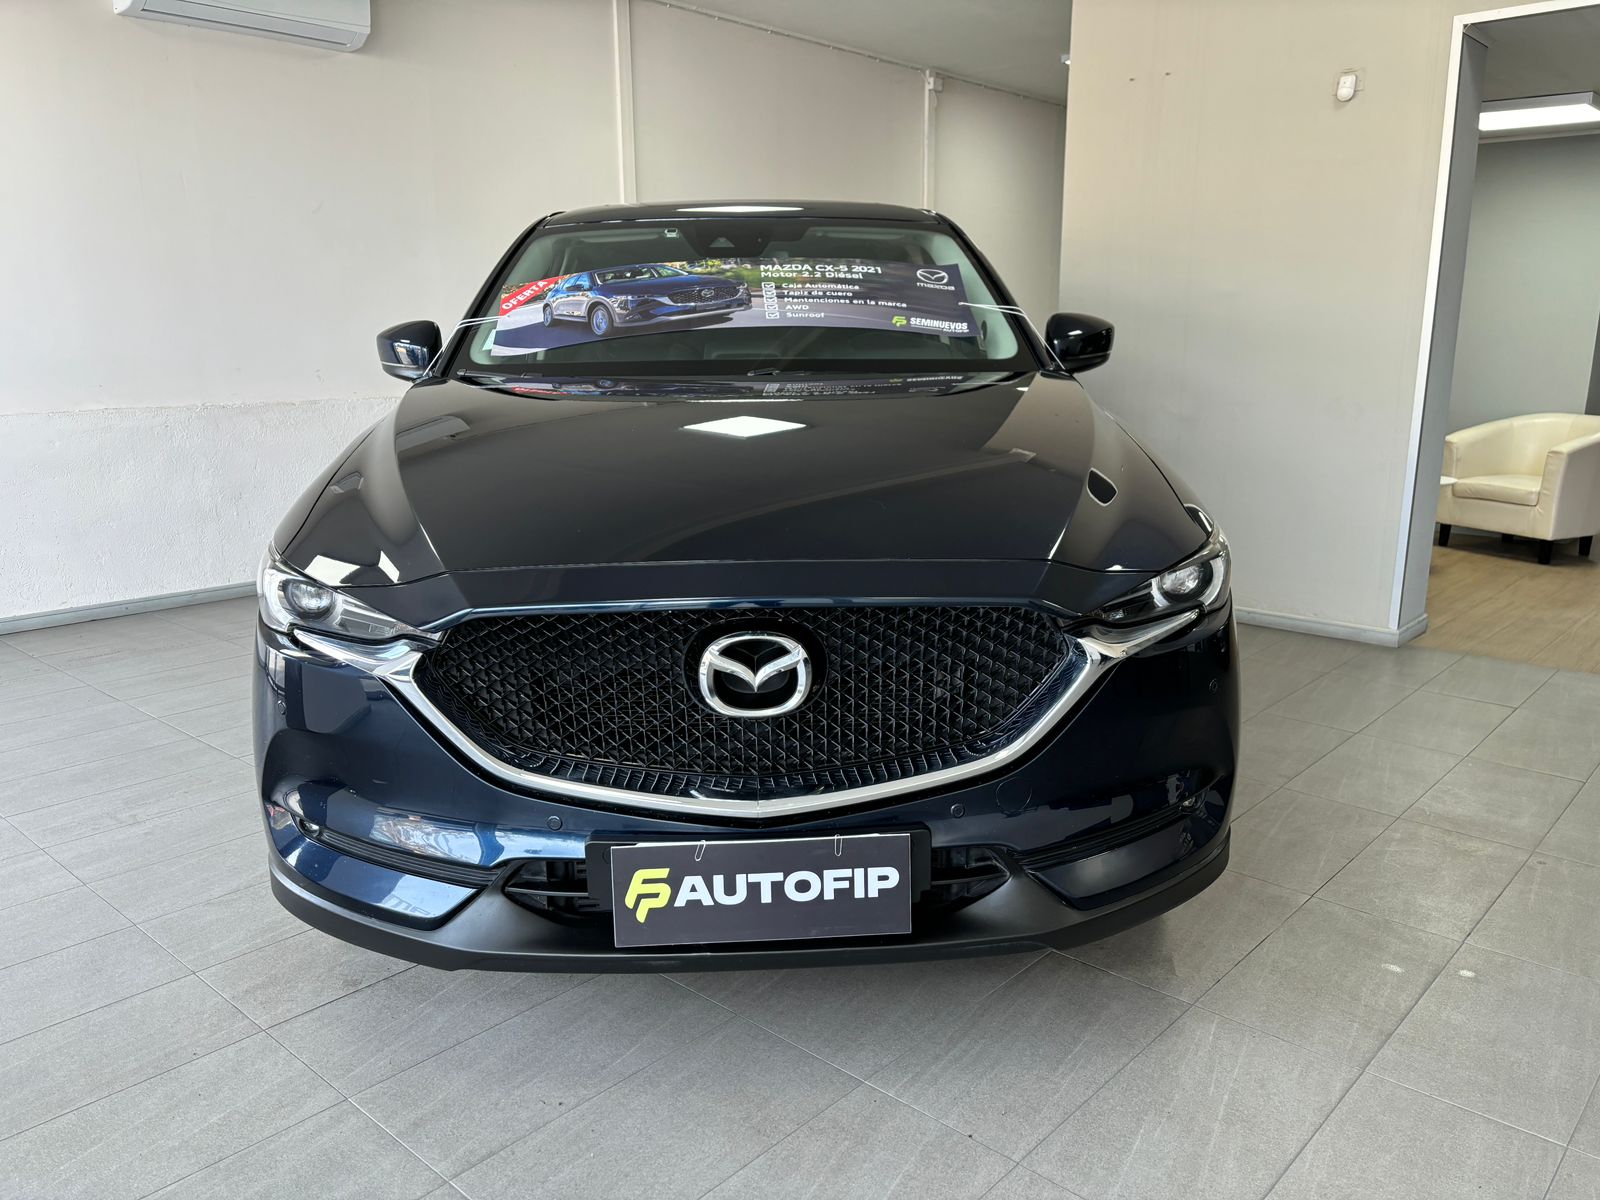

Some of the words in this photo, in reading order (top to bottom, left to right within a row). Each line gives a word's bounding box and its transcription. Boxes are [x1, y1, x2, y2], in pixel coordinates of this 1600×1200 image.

[760, 264, 812, 272] MAZDA
[815, 264, 847, 272] CX-5
[851, 265, 882, 274] 2021
[804, 282, 859, 290] Automática
[501, 281, 548, 310] OFERTA
[909, 317, 968, 330] SEMINUEVOS
[673, 866, 900, 907] AUTOFIP
